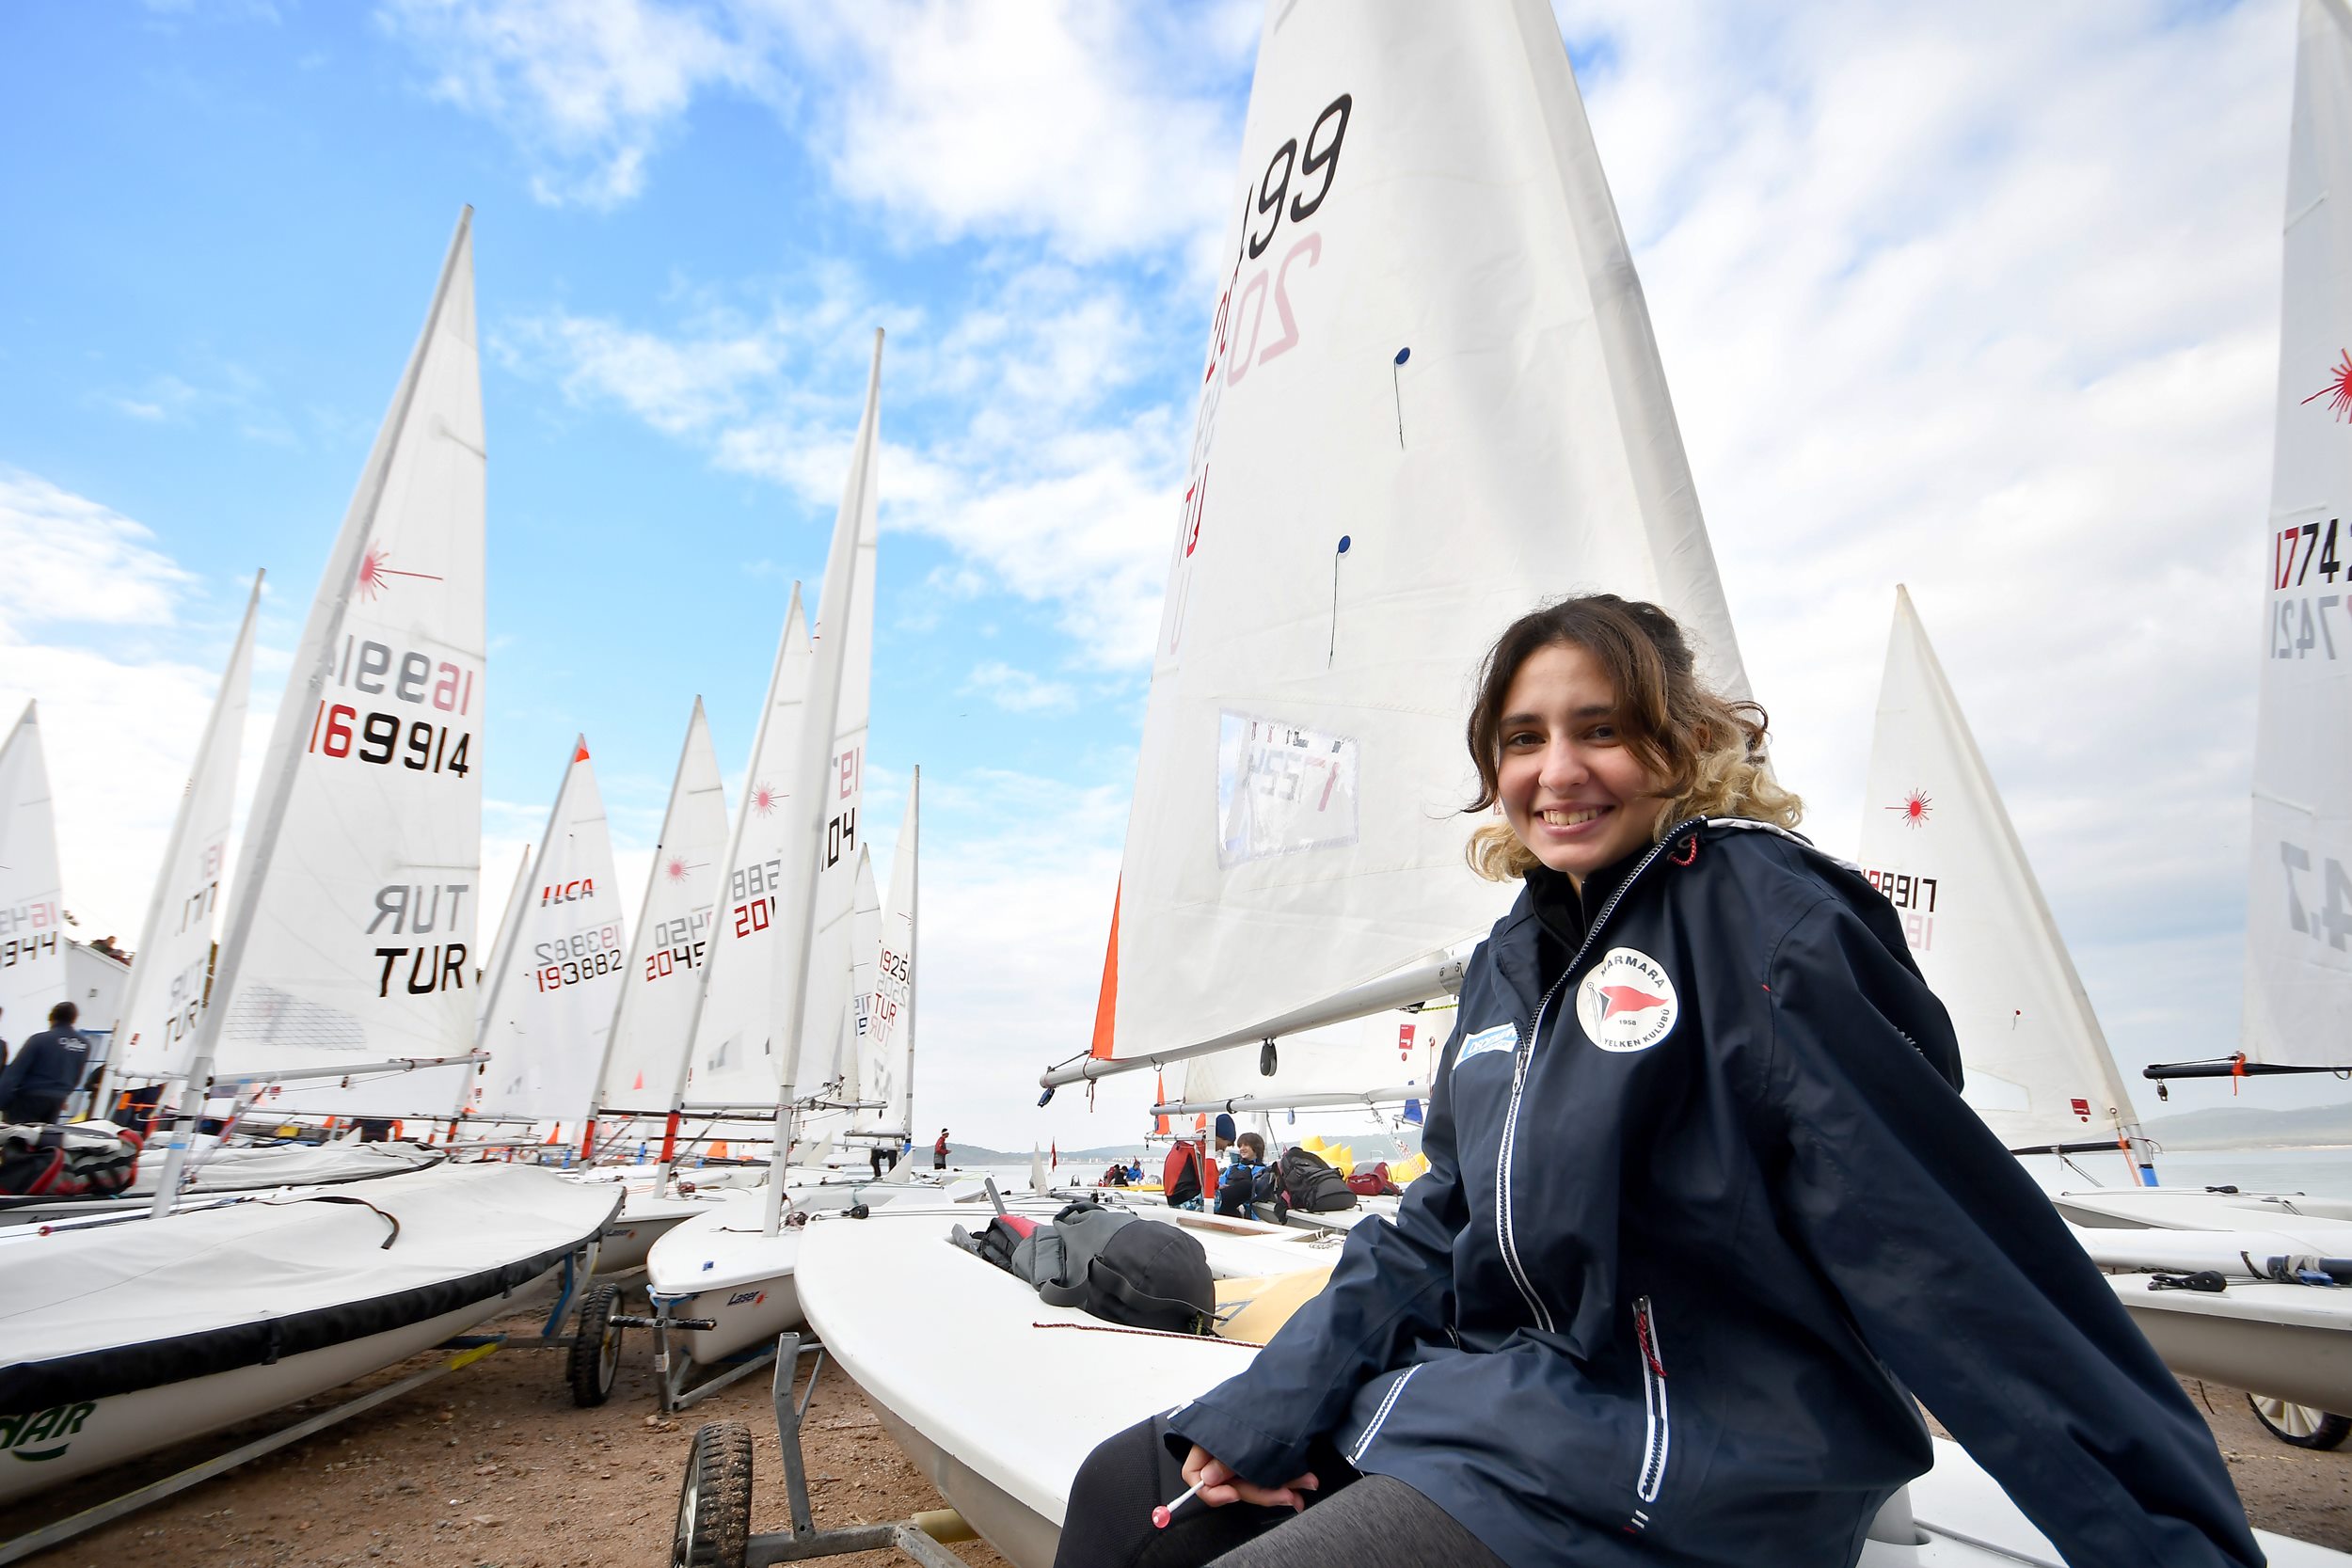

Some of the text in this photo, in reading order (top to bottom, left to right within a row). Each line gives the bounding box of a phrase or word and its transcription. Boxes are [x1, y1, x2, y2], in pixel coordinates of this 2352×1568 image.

[2274, 518, 2352, 591] 1774
[309, 700, 471, 779] 169914
[541, 878, 595, 908] ILCA
[374, 942, 468, 998] TUR
[536, 949, 623, 993] 193882
[1600, 955, 1666, 990] MARMARA
[874, 992, 898, 1027] TUR
[1603, 1007, 1670, 1048] YELKEN KULÜBÜ
[726, 1290, 761, 1307] Laser
